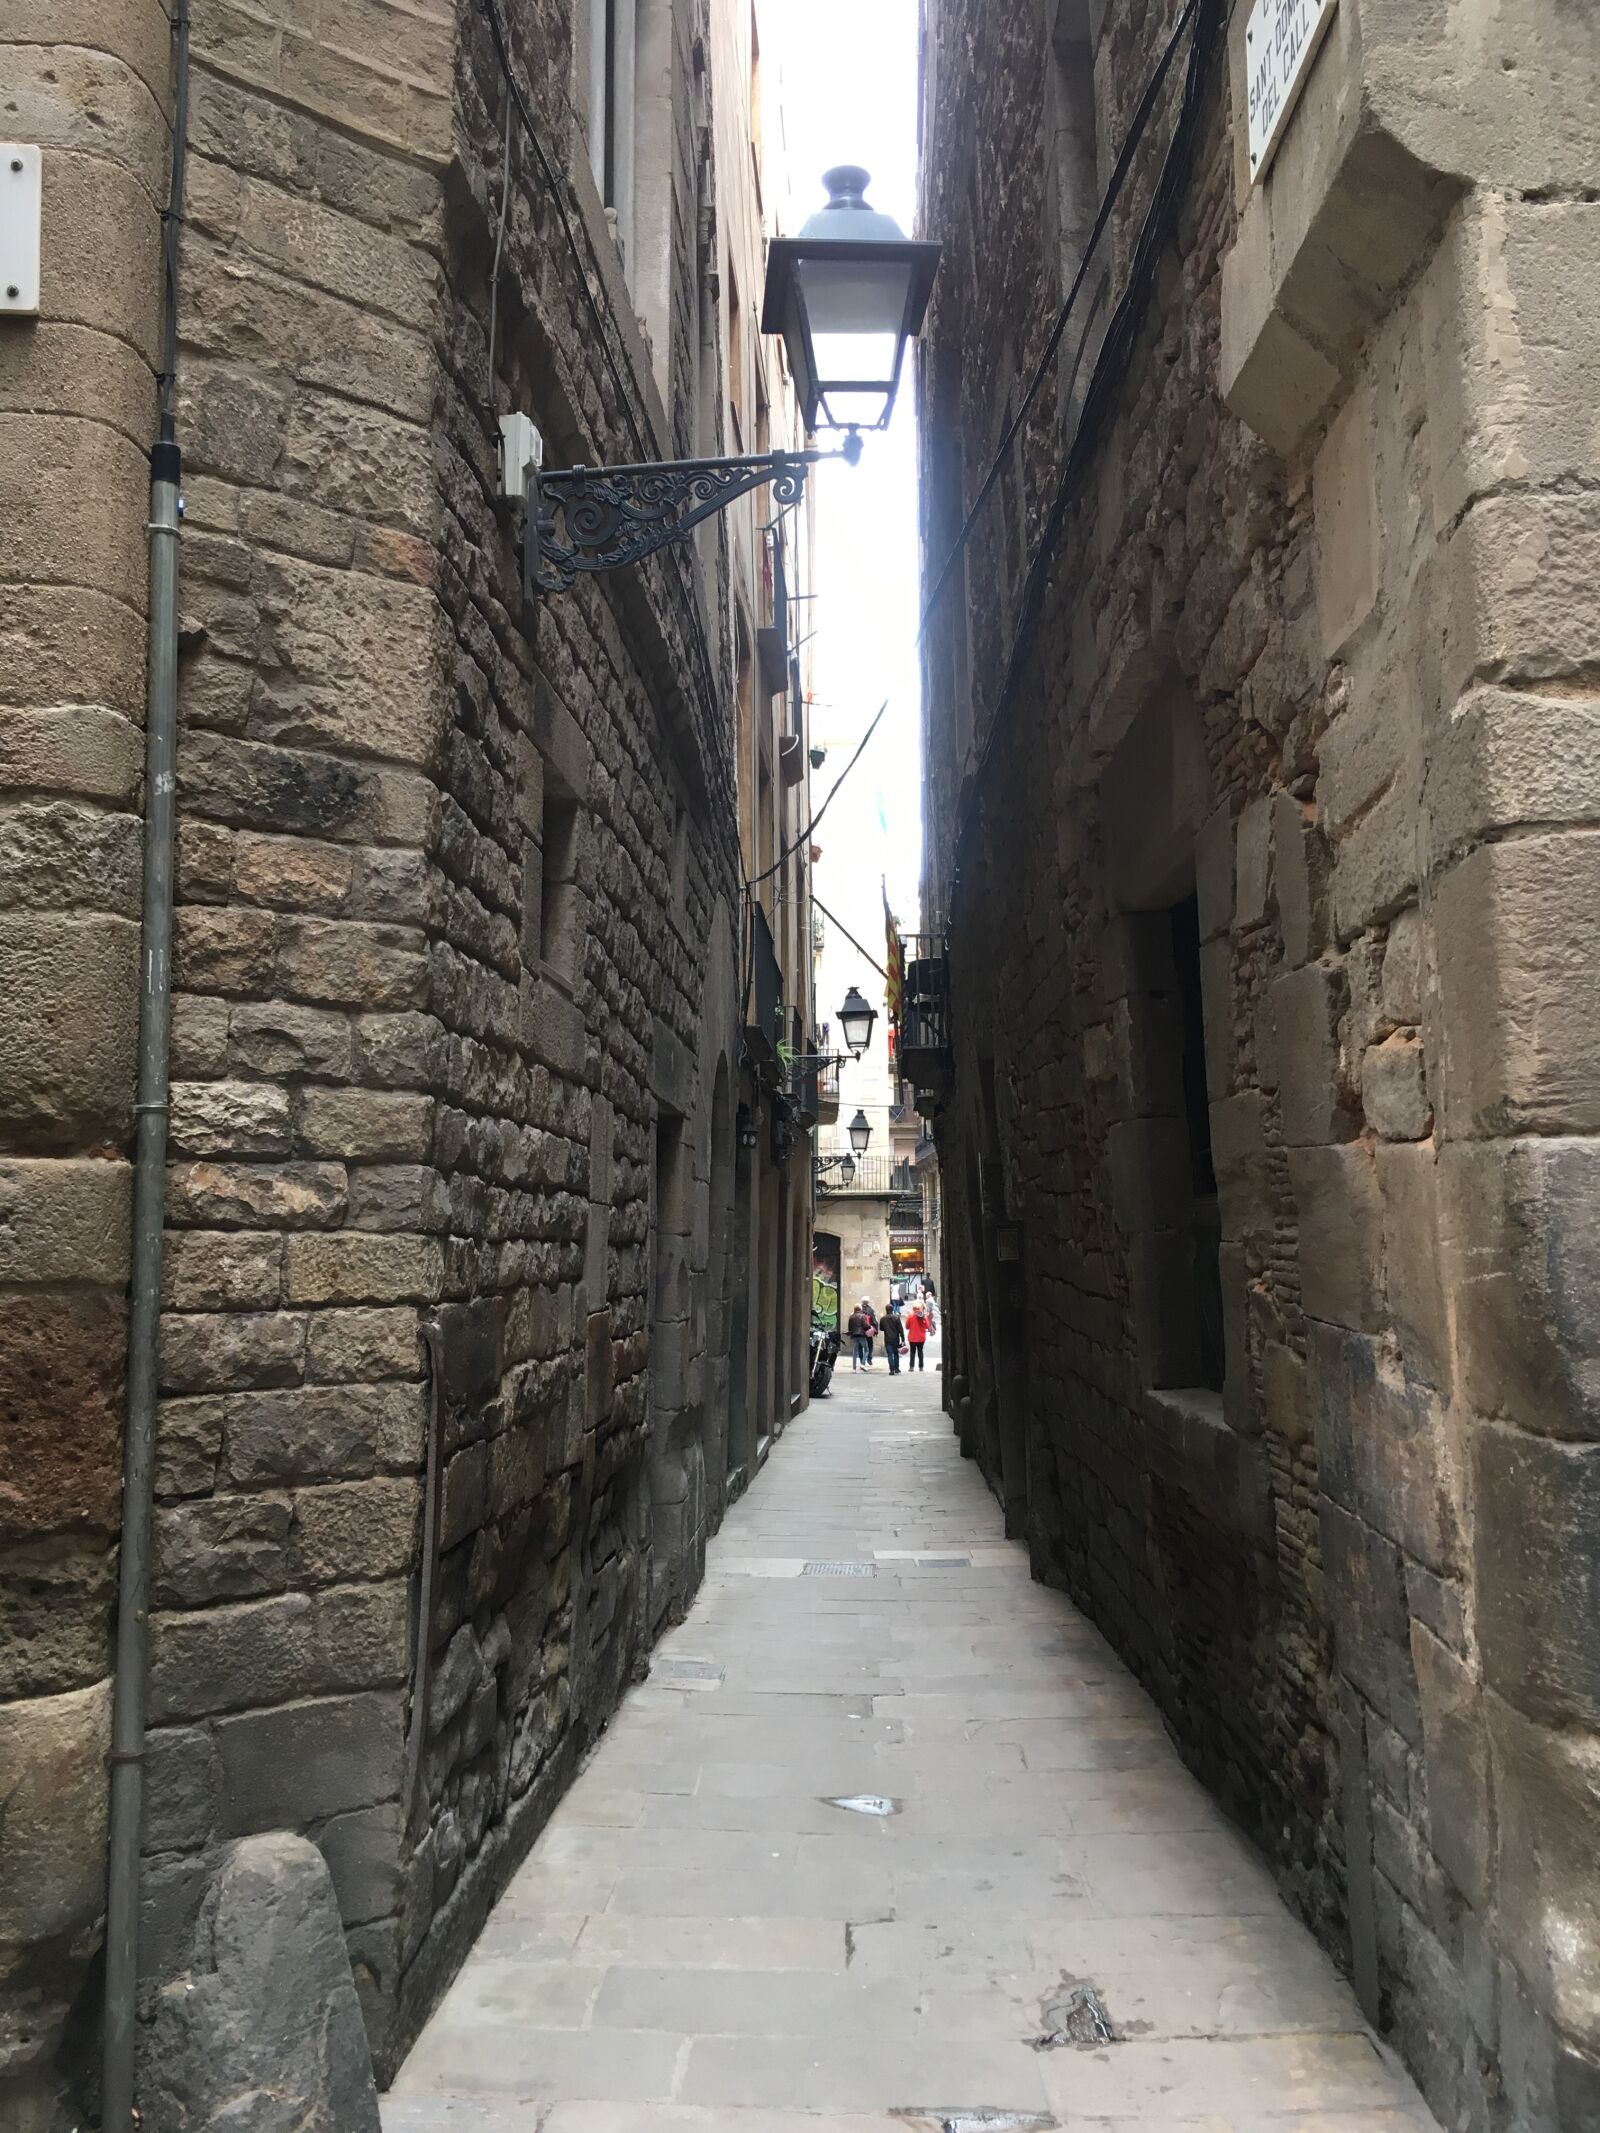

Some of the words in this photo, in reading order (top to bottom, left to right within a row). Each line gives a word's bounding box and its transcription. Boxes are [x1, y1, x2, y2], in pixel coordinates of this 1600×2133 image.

[1249, 40, 1272, 123] SANT
[1262, 76, 1280, 137] DEL
[1283, 3, 1309, 84] CALL
